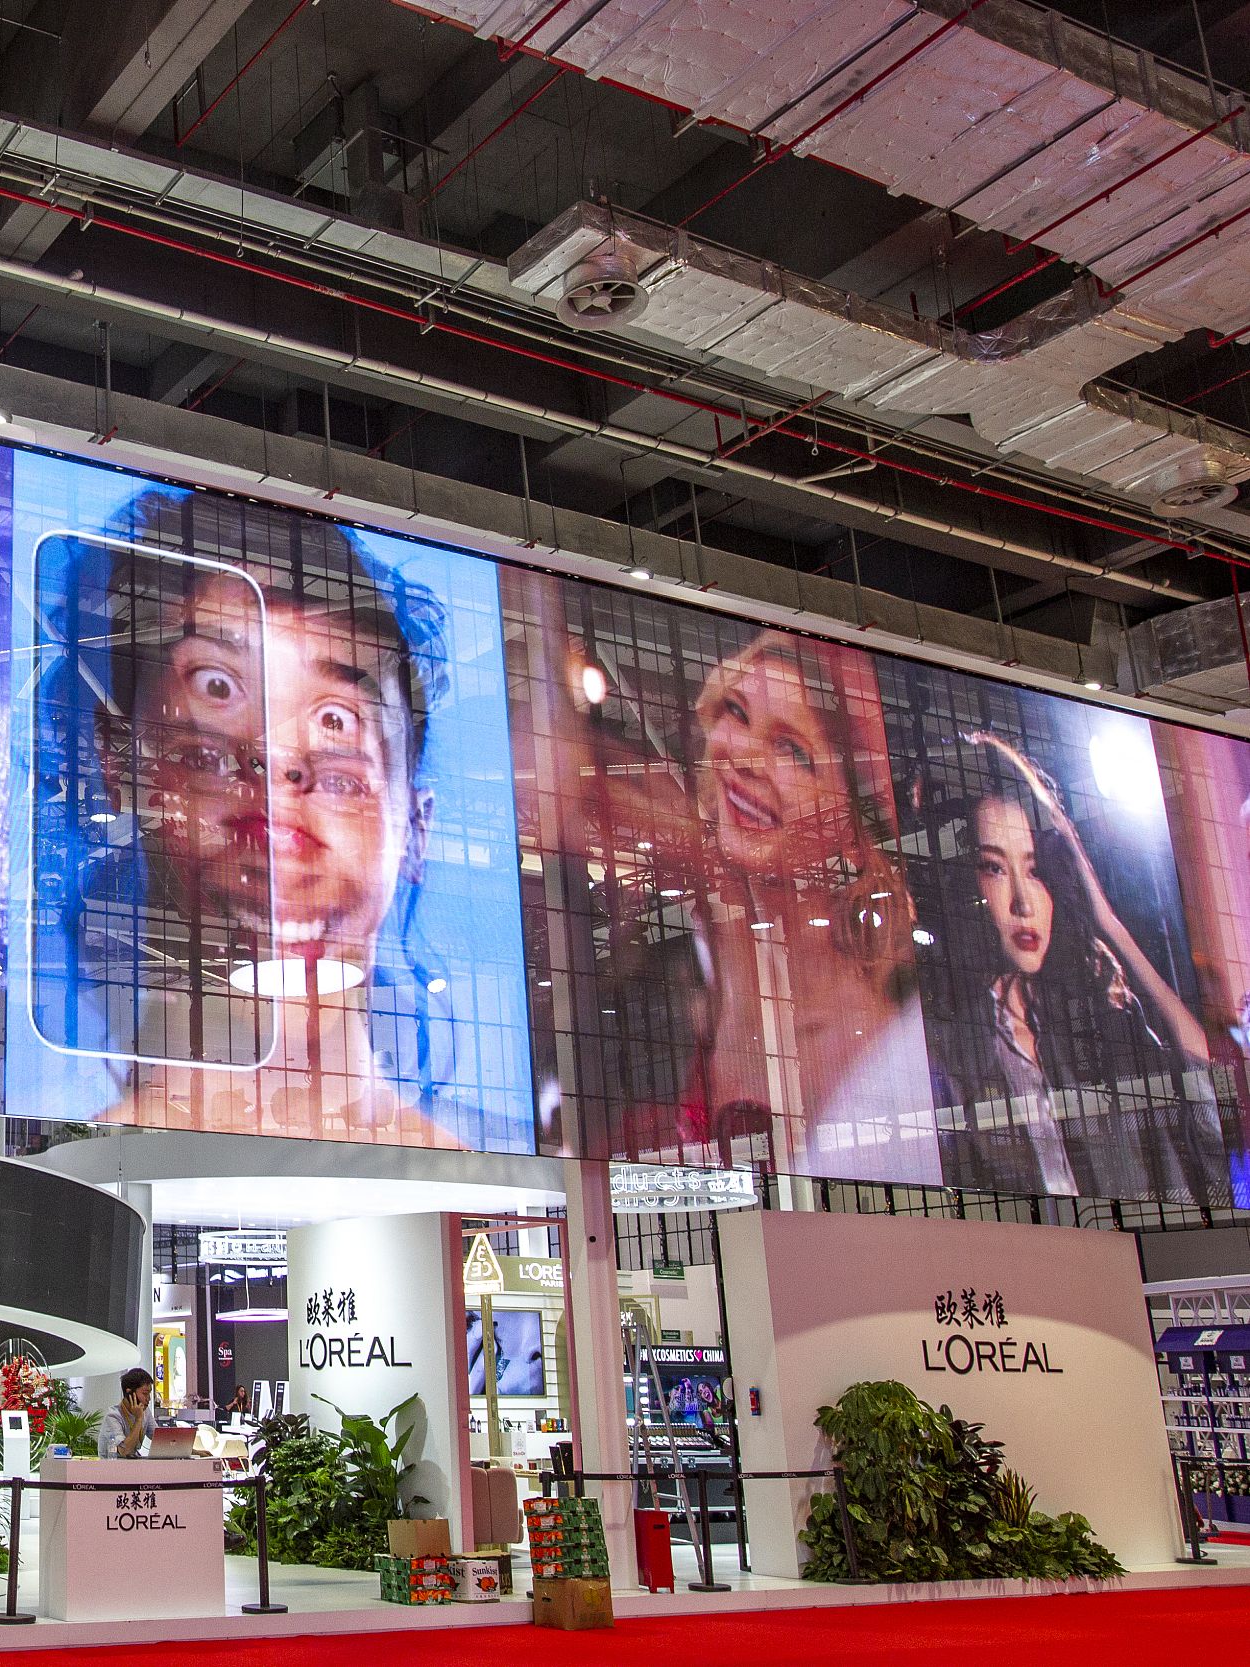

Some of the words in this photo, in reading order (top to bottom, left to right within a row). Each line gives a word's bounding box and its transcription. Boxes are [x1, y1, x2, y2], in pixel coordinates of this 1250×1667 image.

[519, 1262, 563, 1281] L'ORÉ
[306, 1287, 358, 1328] 欧莱雅
[934, 1287, 1009, 1329] 欧莱雅
[218, 1346, 233, 1358] Spa
[299, 1333, 412, 1371] L'ORÉAL
[702, 1349, 725, 1362] CHINA
[921, 1334, 1064, 1375] L'ORÉAL
[116, 1491, 157, 1511] 欧莱雅
[106, 1512, 187, 1532] L'ORÉAL
[472, 1565, 497, 1576] Sunkist
